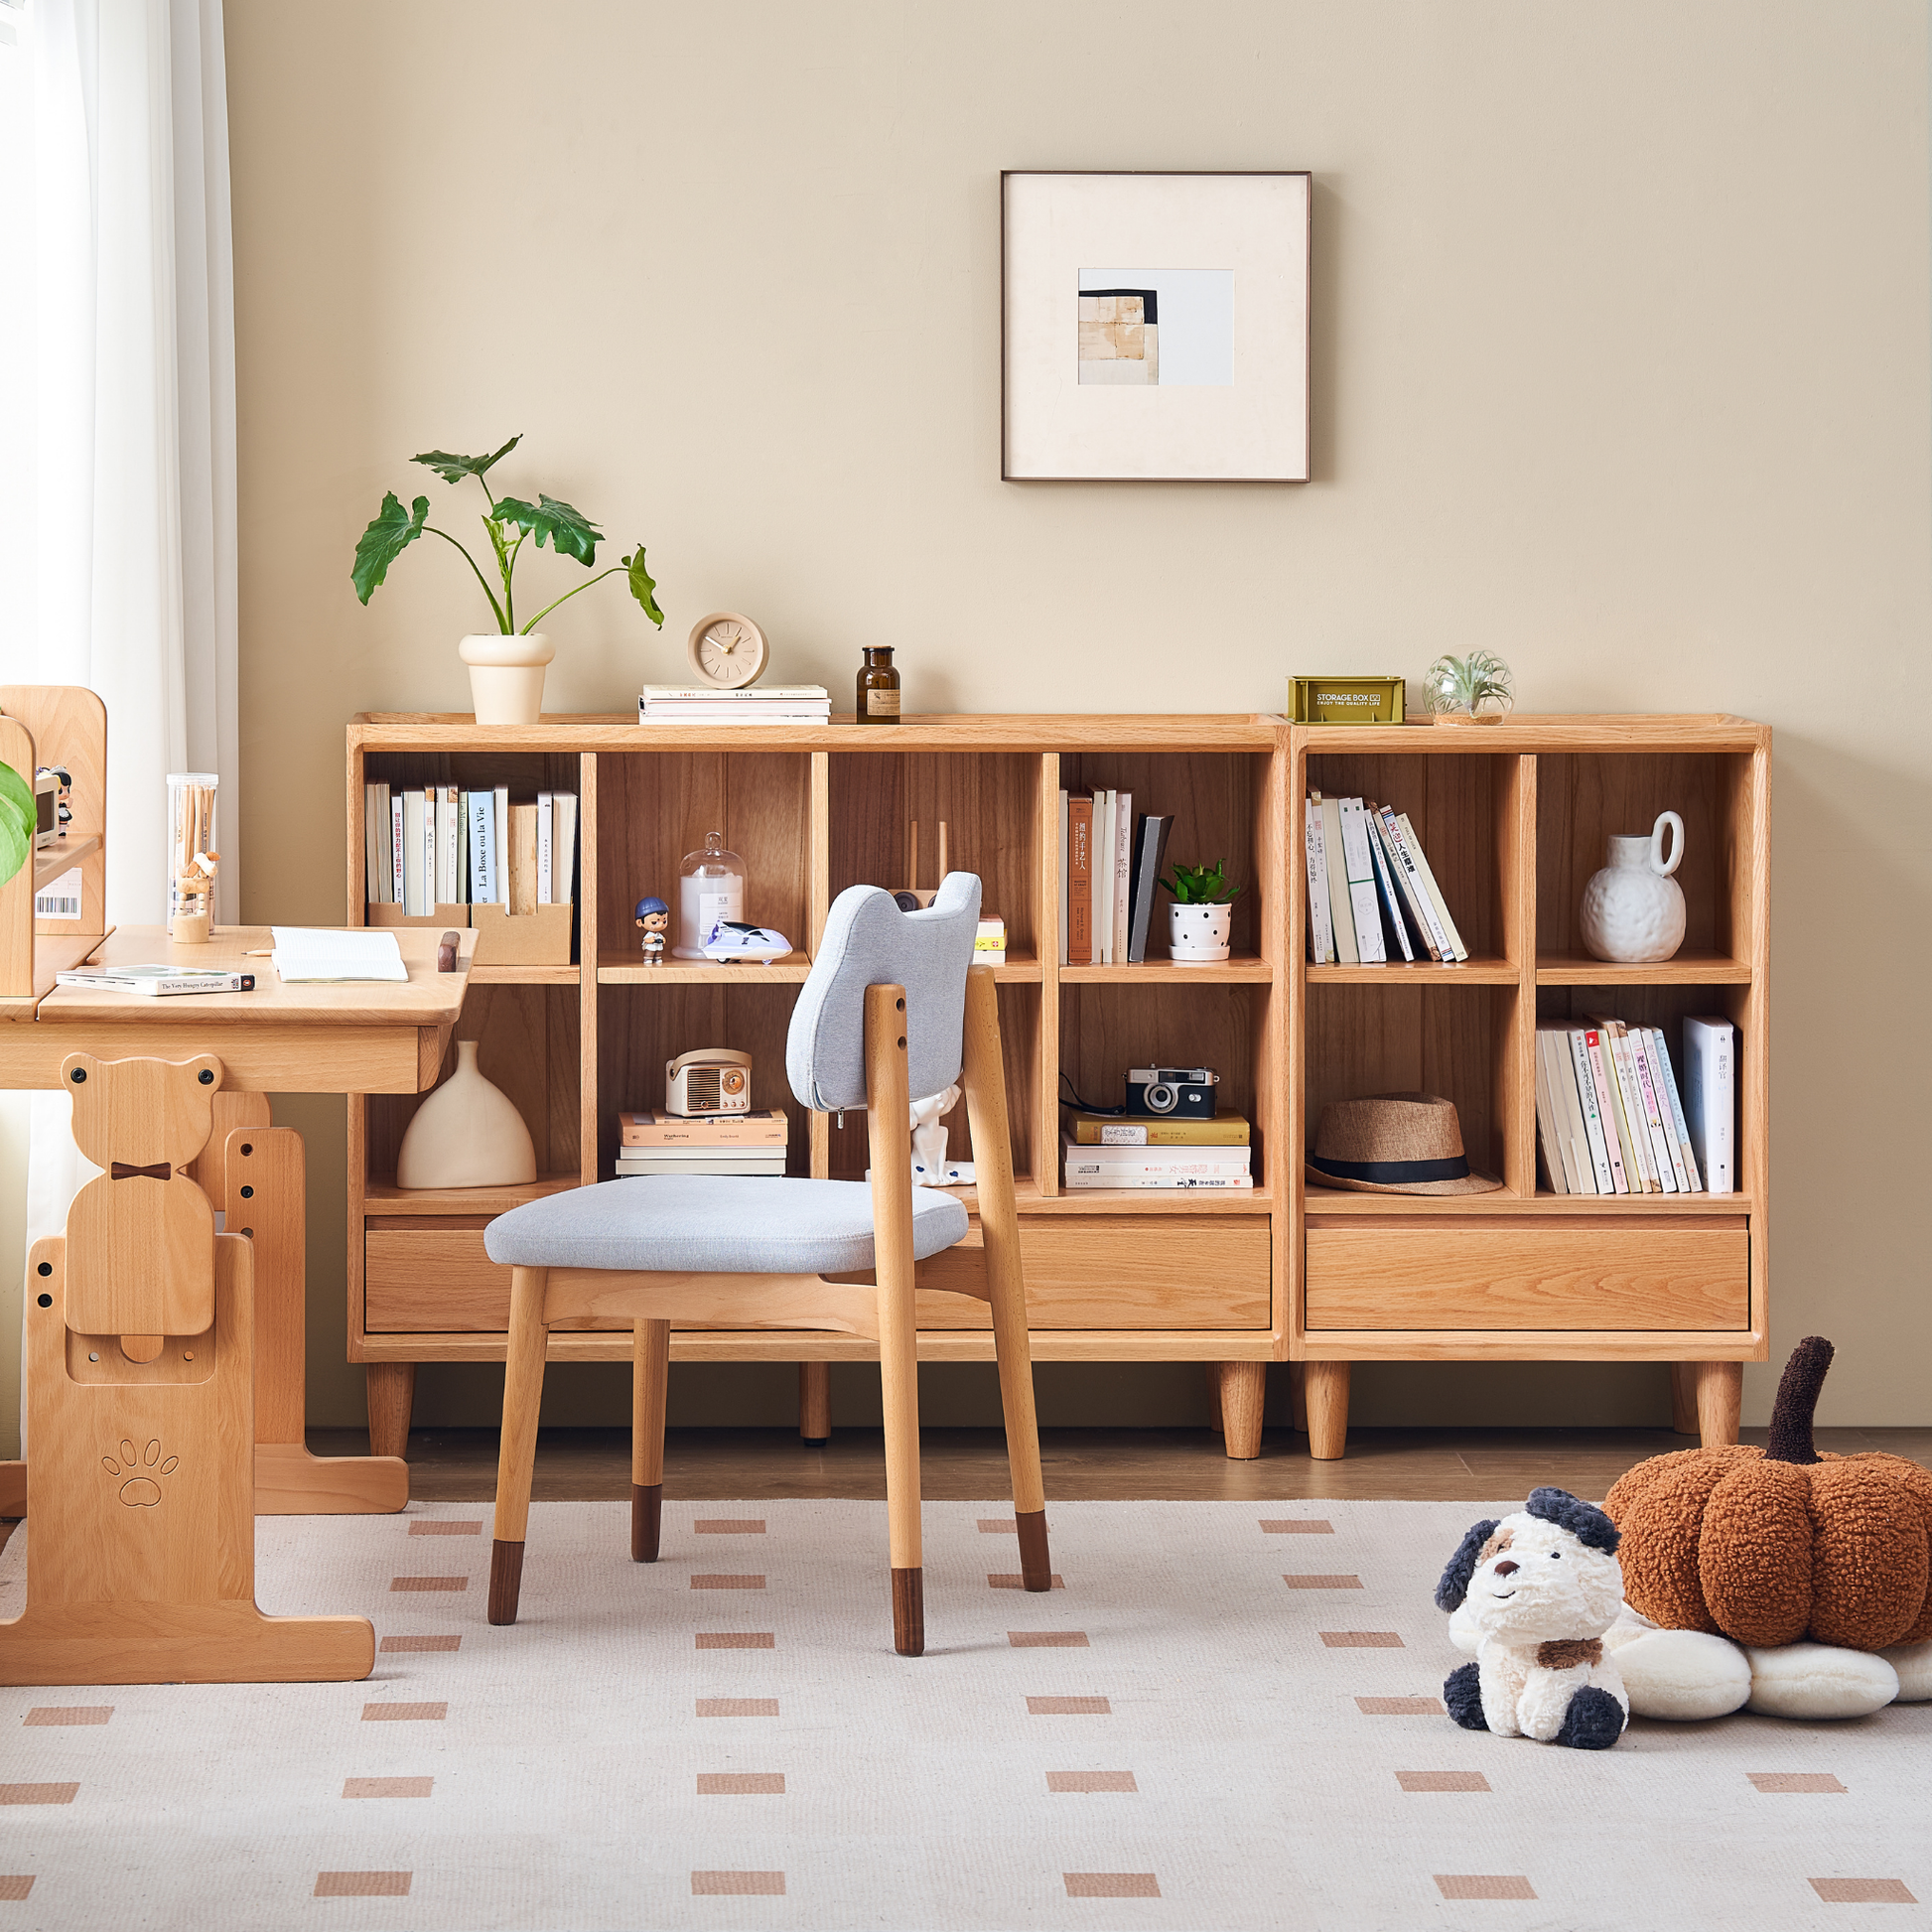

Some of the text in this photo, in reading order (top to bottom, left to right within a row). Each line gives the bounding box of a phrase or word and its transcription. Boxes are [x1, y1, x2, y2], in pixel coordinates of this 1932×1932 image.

[476, 806, 485, 822] Vie
[477, 824, 485, 833] la
[479, 835, 486, 847] ou
[478, 849, 487, 873] Boxe
[1116, 858, 1128, 879] 茶馆
[479, 875, 487, 888] La
[1636, 1054, 1651, 1088] 裸婚时代
[1719, 1054, 1727, 1080] 翻译官
